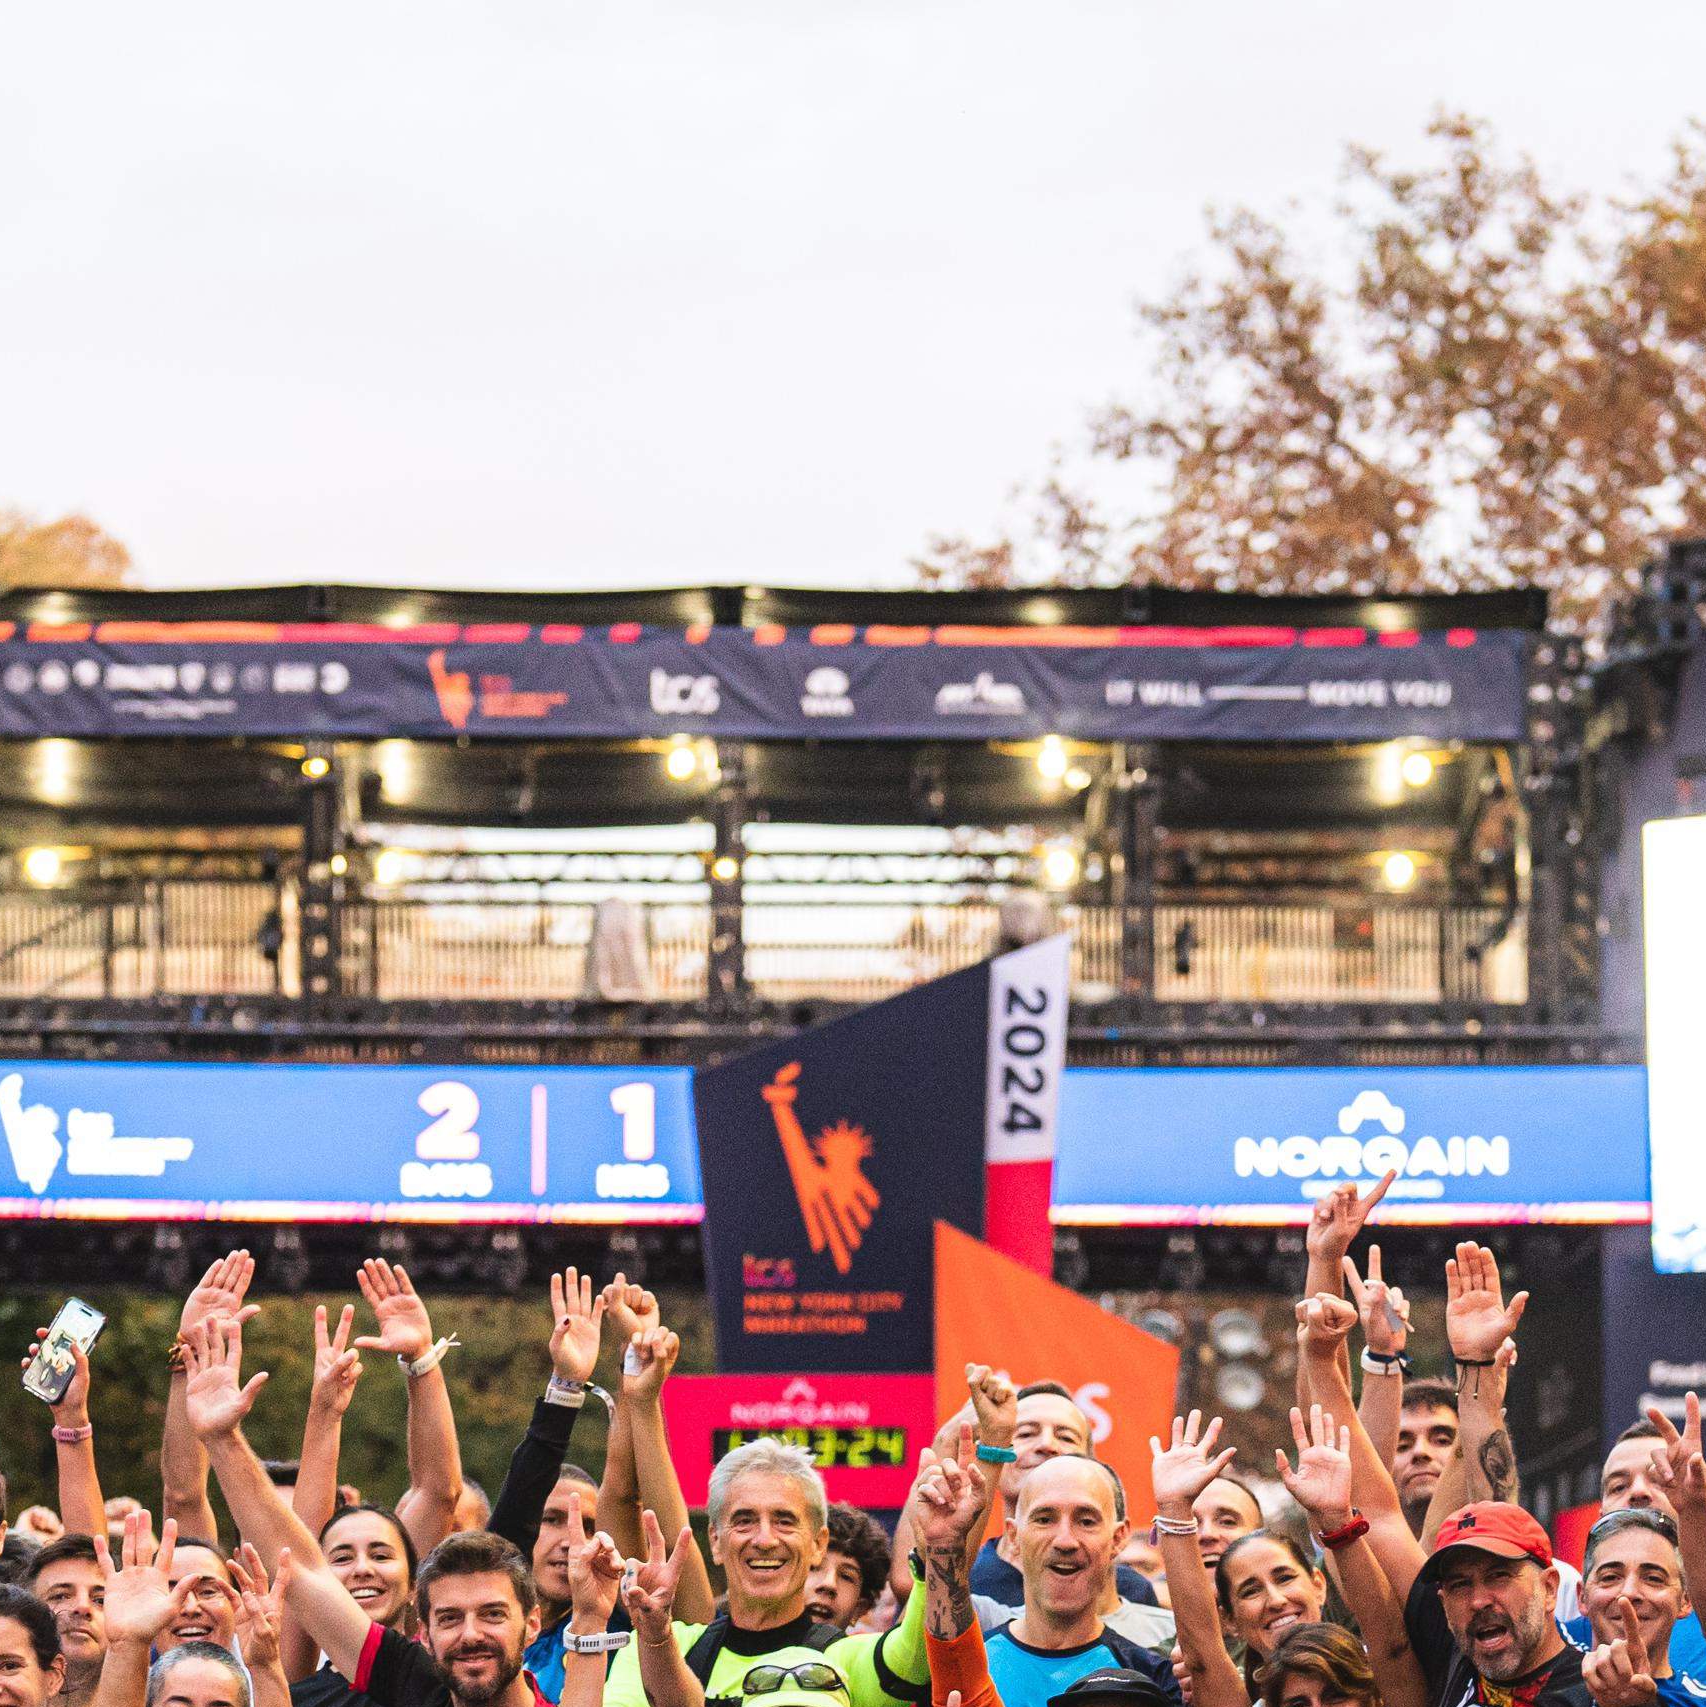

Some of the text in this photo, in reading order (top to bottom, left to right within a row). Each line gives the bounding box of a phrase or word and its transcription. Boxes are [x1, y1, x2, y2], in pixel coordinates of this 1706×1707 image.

[650, 669, 721, 714] tcs
[1139, 682, 1203, 706] WILL
[1308, 682, 1387, 707] MOVE
[1393, 683, 1452, 707] YOU
[1003, 987, 1048, 1135] 2024
[418, 1081, 481, 1160] 2
[608, 1082, 655, 1161] 1
